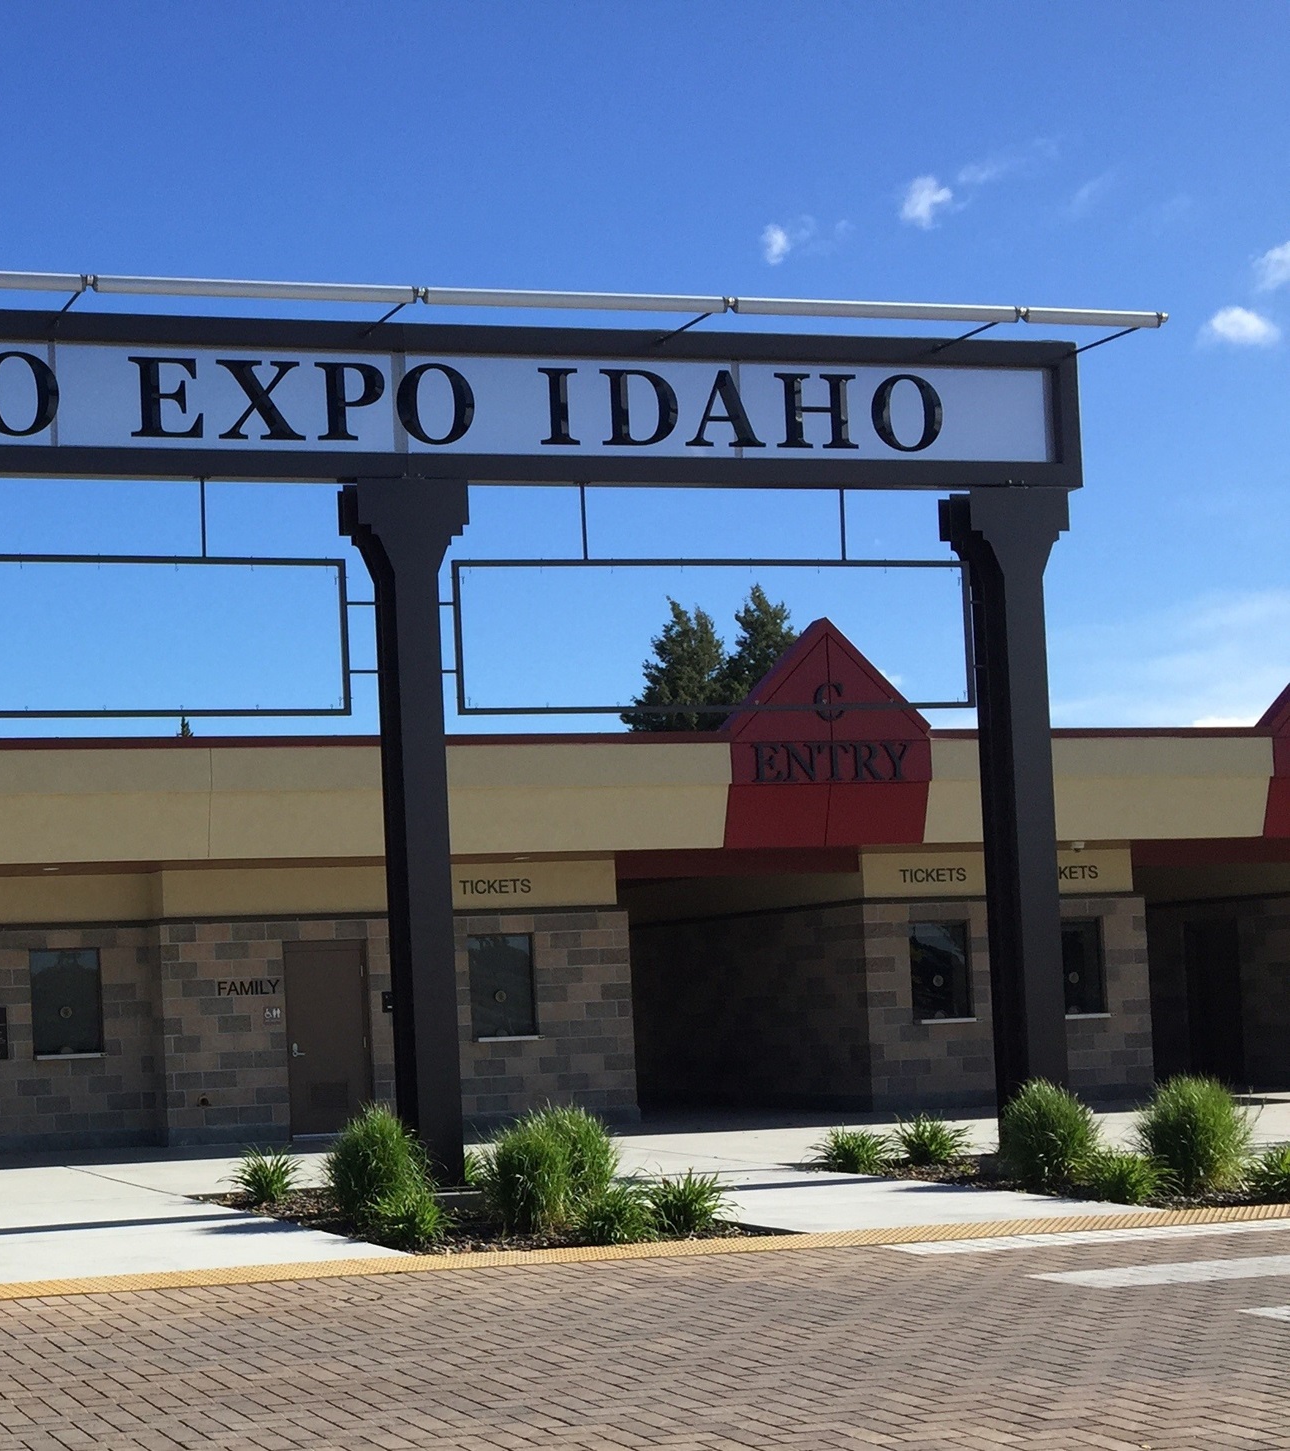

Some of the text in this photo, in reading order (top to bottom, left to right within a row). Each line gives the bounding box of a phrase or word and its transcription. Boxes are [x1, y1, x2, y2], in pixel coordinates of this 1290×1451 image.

[127, 356, 476, 446] EXPO
[537, 367, 944, 453] IDAHO
[813, 682, 844, 722] C
[751, 739, 910, 783] ENTRY
[899, 867, 967, 883] TICKETS
[1058, 865, 1099, 880] KETS
[459, 878, 532, 895] TICKETS
[217, 979, 280, 996] FAMILY
